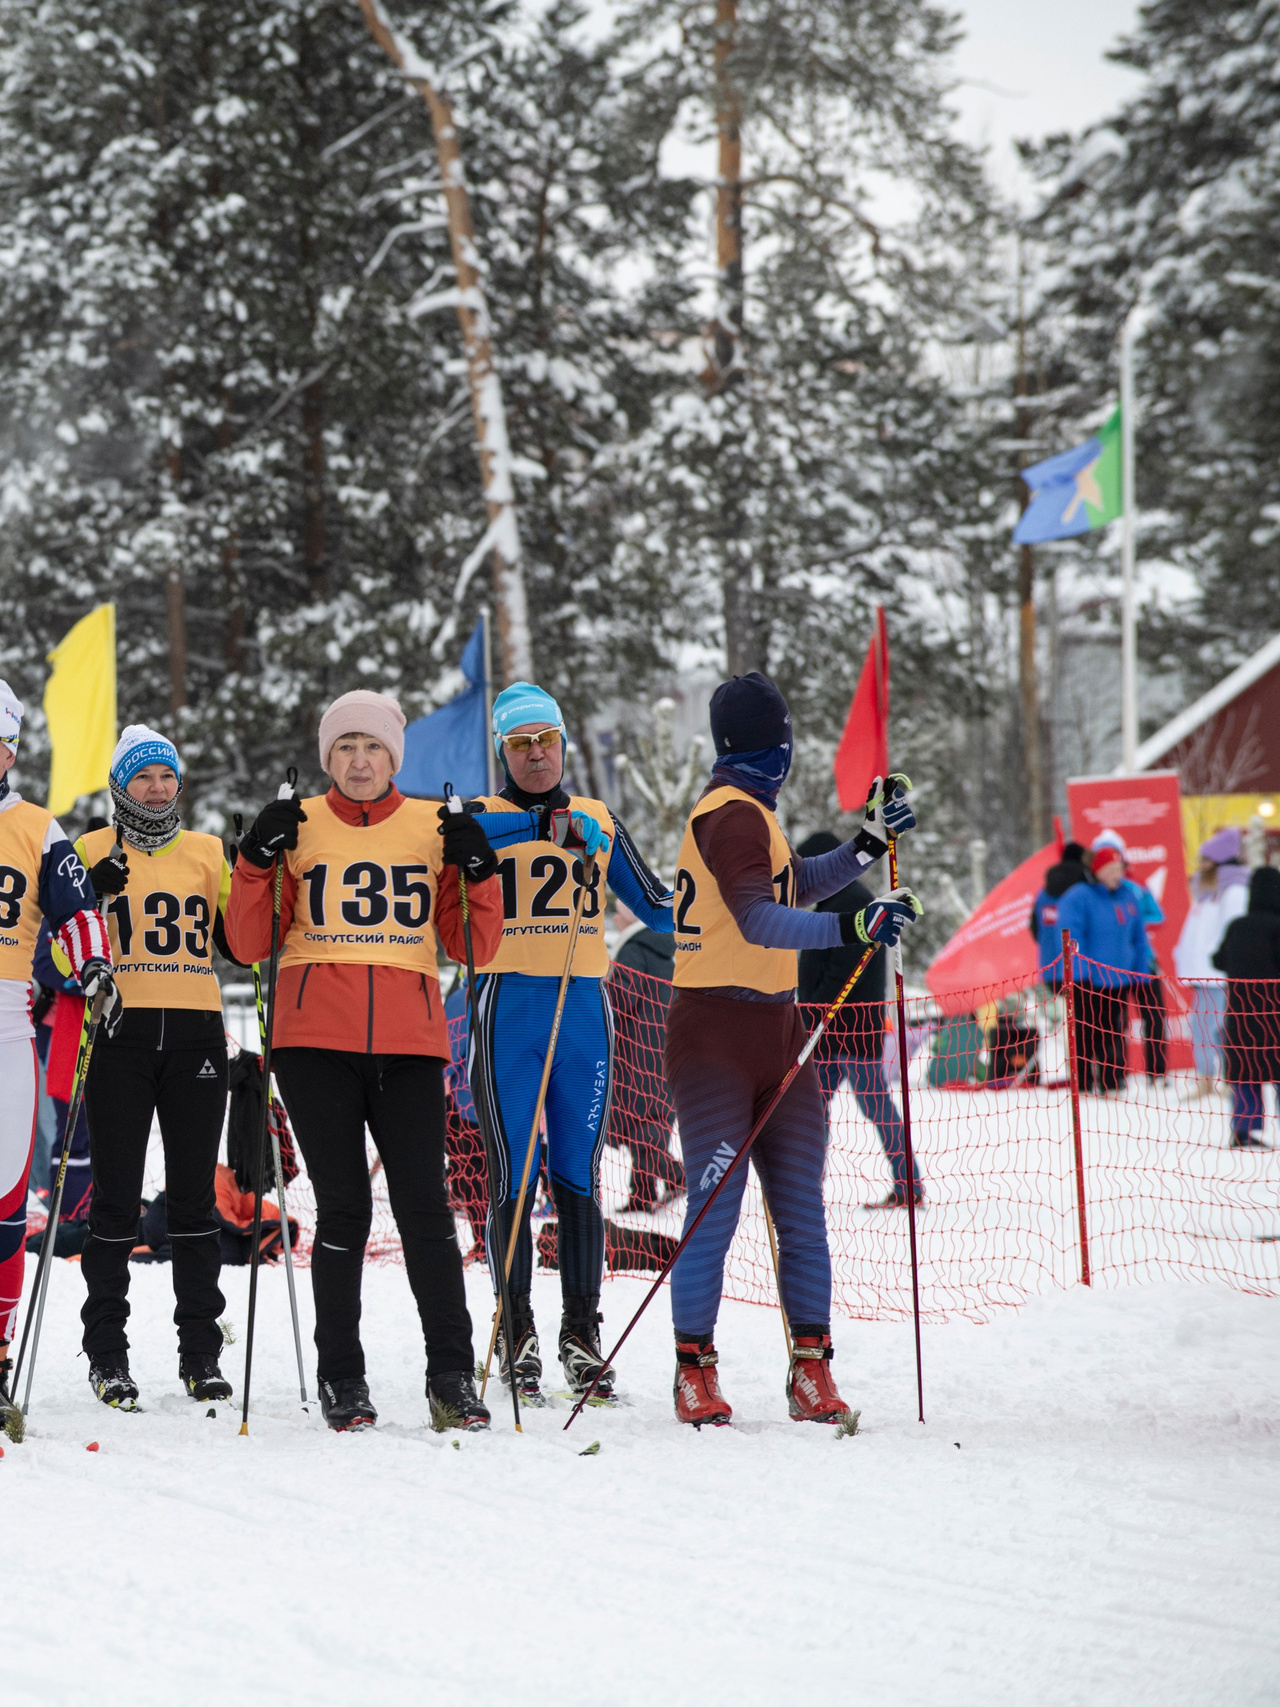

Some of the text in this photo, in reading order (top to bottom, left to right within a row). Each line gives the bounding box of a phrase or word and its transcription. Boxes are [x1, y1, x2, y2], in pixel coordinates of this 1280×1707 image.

[125, 746, 174, 771] РОССИИ
[302, 860, 432, 928] 135
[496, 854, 601, 920] 128
[107, 891, 210, 959] 133
[304, 932, 425, 945] СУРГУТСКИЙ РАЙОН
[502, 923, 598, 936] УРГУТСКИЙ АЙОН
[113, 962, 214, 975] УРГУТСКИЙ РАЙОН
[80, 1043, 93, 1082] SWIX
[56, 1150, 70, 1188] SWIX
